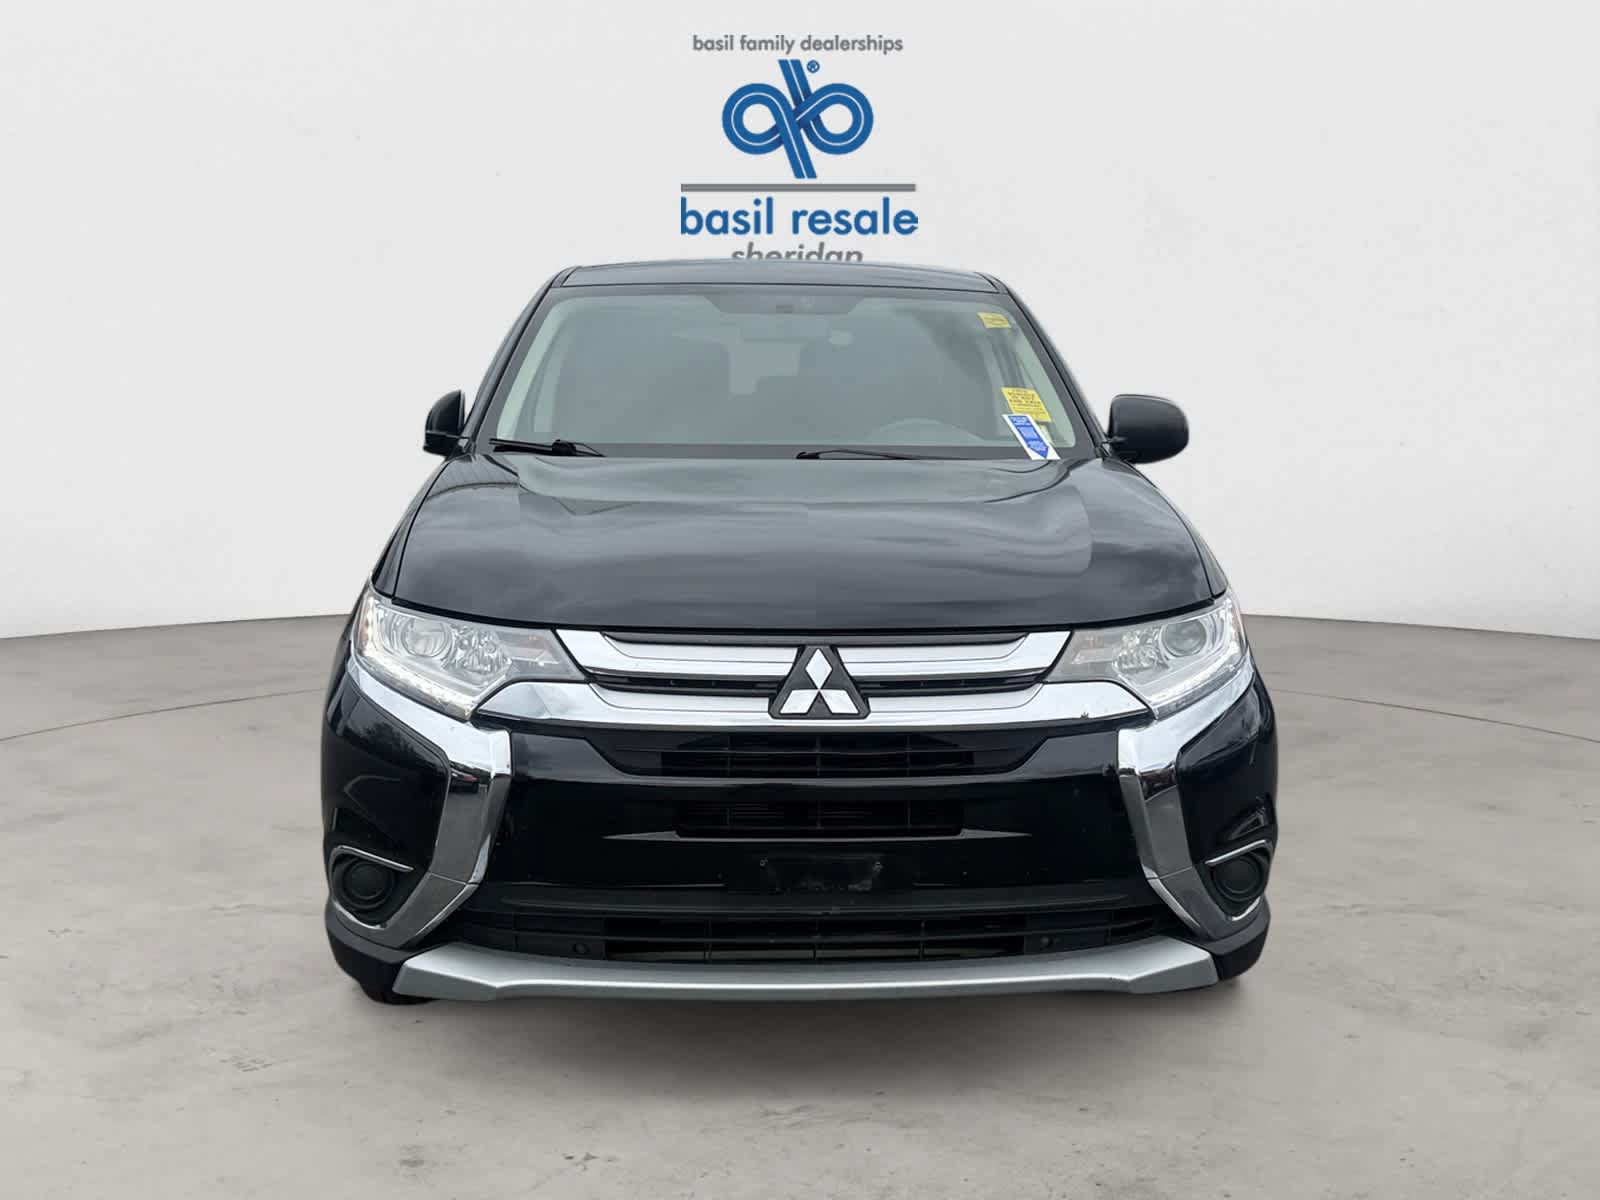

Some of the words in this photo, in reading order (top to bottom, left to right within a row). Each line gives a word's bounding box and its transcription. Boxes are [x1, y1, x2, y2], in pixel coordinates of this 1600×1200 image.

[693, 35, 734, 51] basil
[740, 35, 795, 55] family
[800, 35, 903, 55] dealerships
[681, 197, 773, 235] basil
[792, 197, 919, 235] resale
